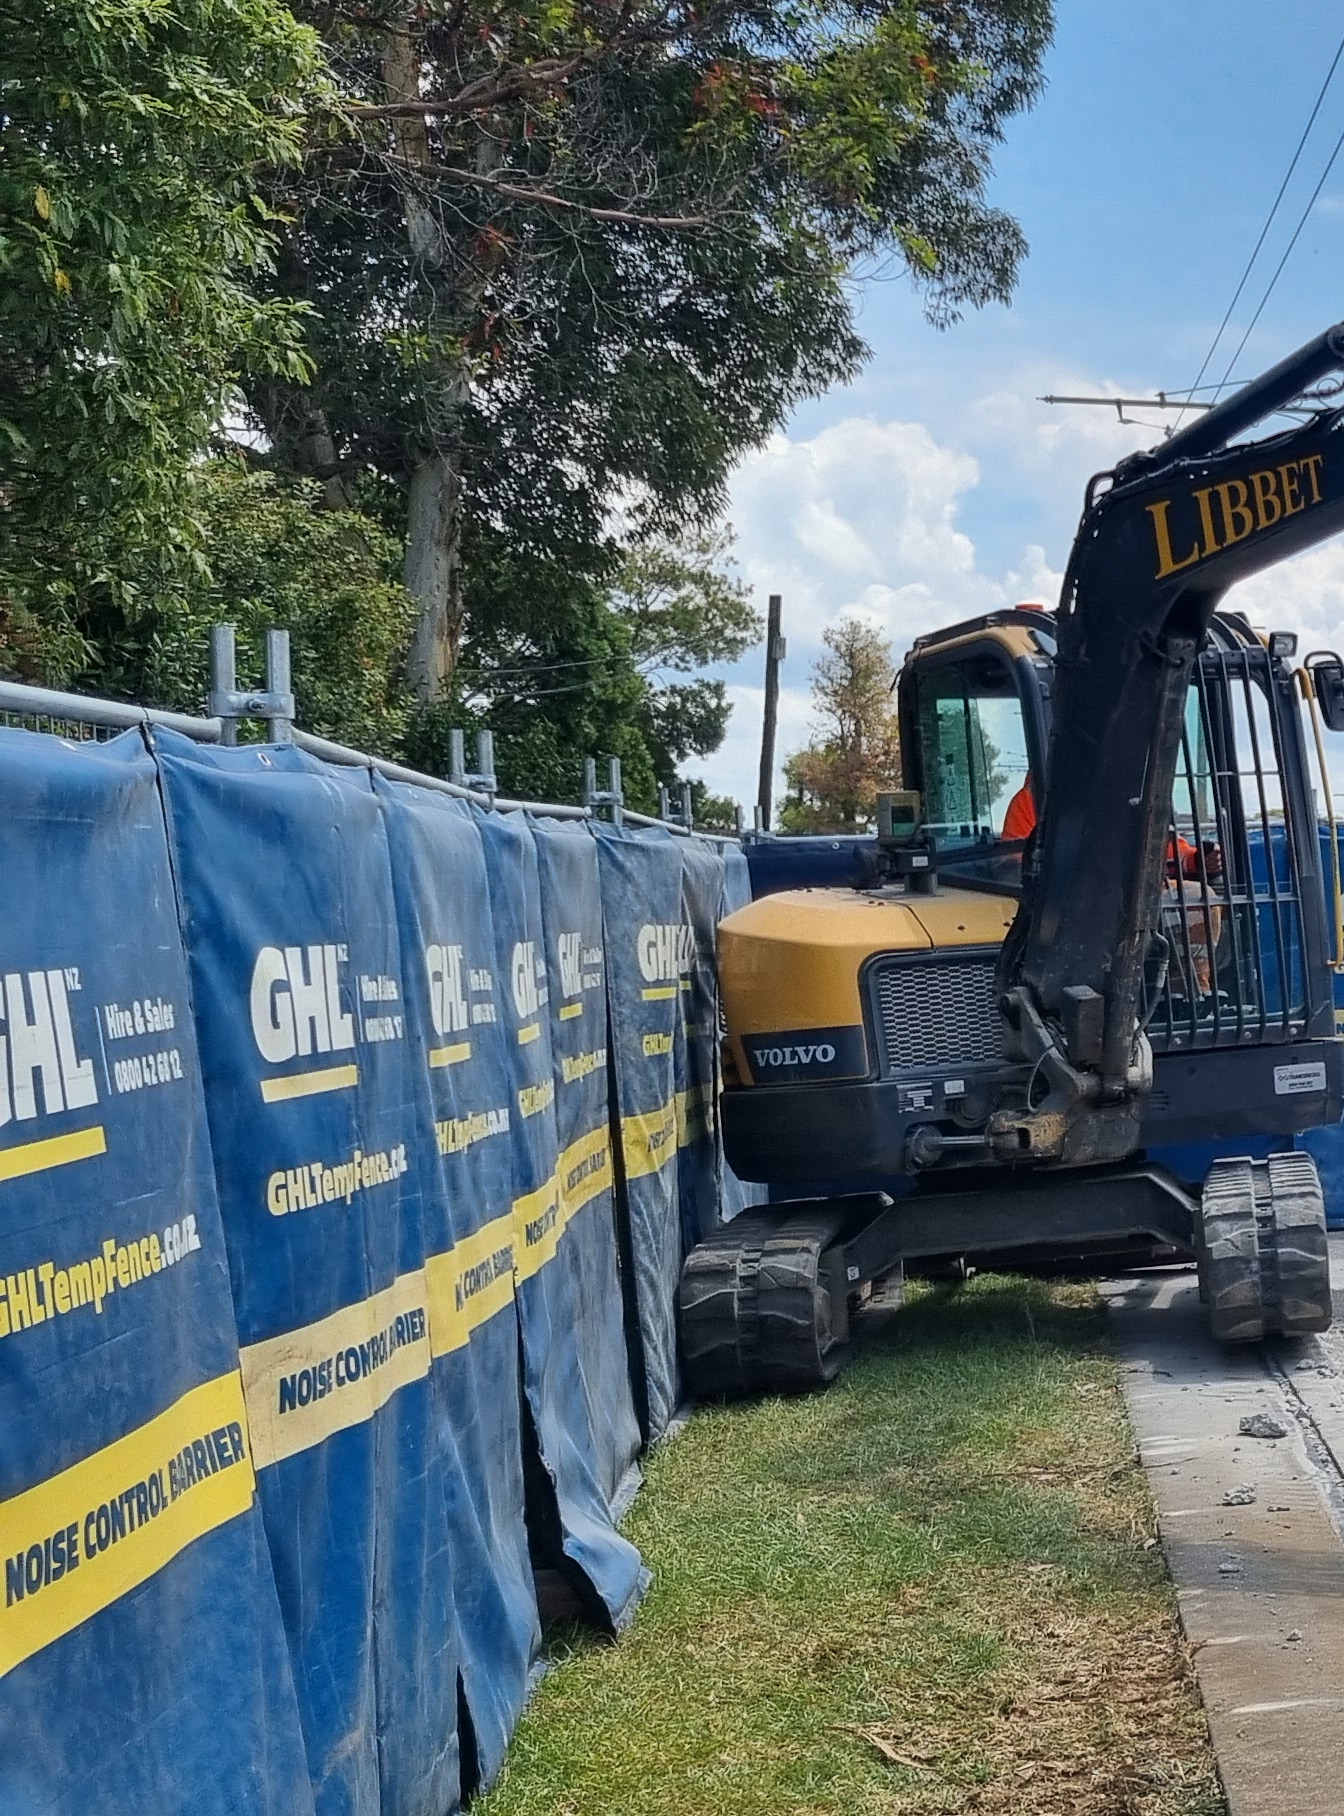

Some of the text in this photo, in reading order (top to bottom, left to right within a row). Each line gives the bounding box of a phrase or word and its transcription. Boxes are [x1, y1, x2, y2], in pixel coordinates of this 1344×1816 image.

[1145, 454, 1323, 581] LIBBET
[105, 997, 175, 1040] Hire & Sales
[250, 944, 356, 1063] GHL
[426, 944, 468, 1036] GHL
[0, 968, 99, 1128] HL NZ
[114, 1057, 143, 1094] 0800
[755, 1043, 836, 1068] VOLVO
[279, 1358, 334, 1415] NOISE
[6, 1520, 80, 1608] NOISE
[84, 1466, 169, 1560] CONTROL
